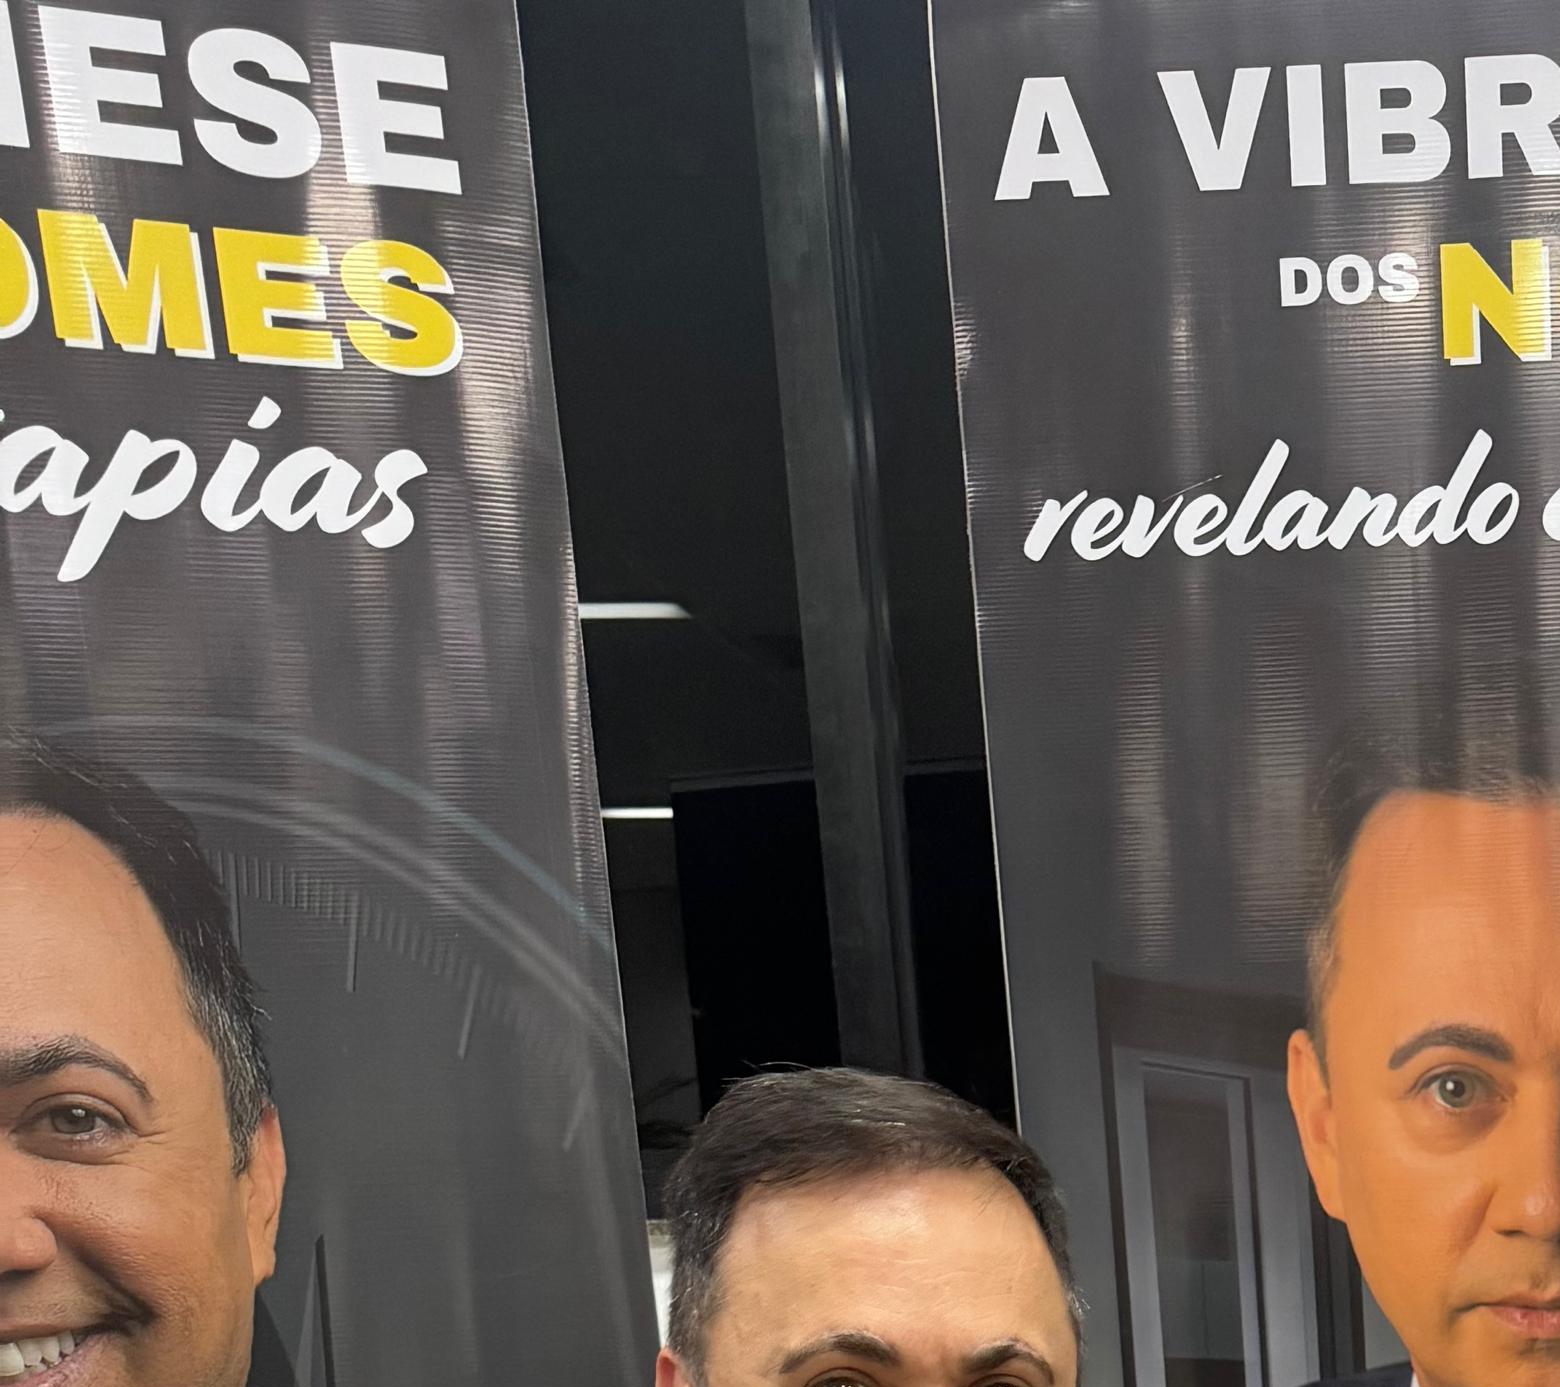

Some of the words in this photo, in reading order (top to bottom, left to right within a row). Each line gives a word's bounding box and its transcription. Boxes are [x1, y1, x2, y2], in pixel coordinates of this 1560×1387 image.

[995, 76, 1110, 200] A
[0, 208, 463, 377] MES
[1279, 253, 1420, 307] DOS
[0, 396, 428, 582] apias
[1023, 429, 1520, 562] revelando
